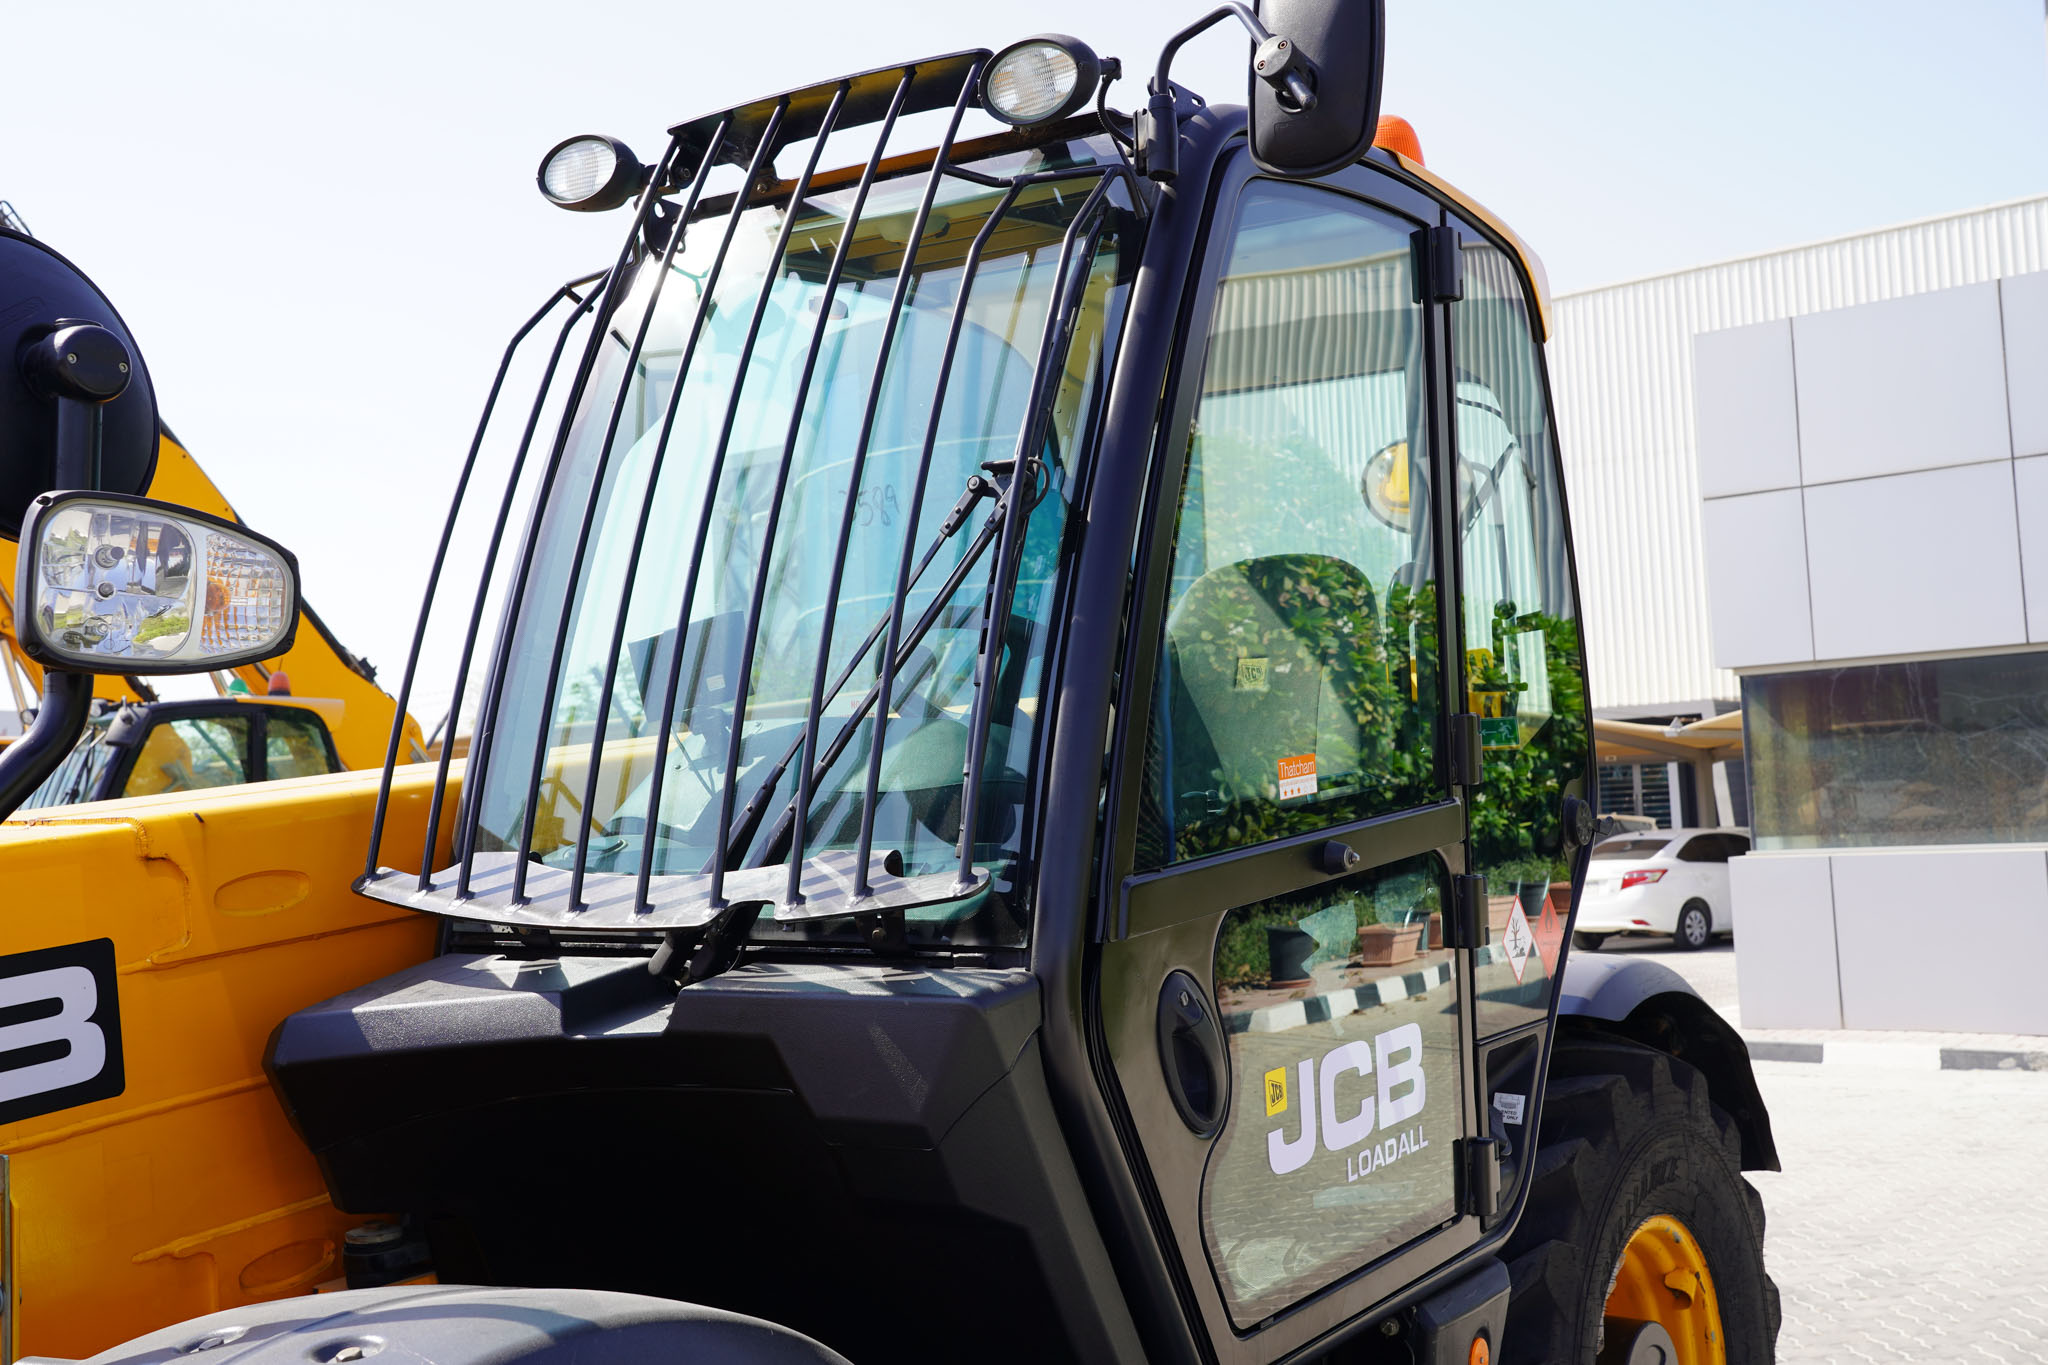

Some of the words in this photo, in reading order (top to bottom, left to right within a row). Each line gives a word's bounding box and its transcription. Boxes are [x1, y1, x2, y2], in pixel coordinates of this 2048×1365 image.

[1280, 759, 1315, 778] Thatcham
[1267, 1022, 1426, 1175] JCB
[1270, 1082, 1284, 1104] JCB
[1347, 1125, 1429, 1182] LOADALL
